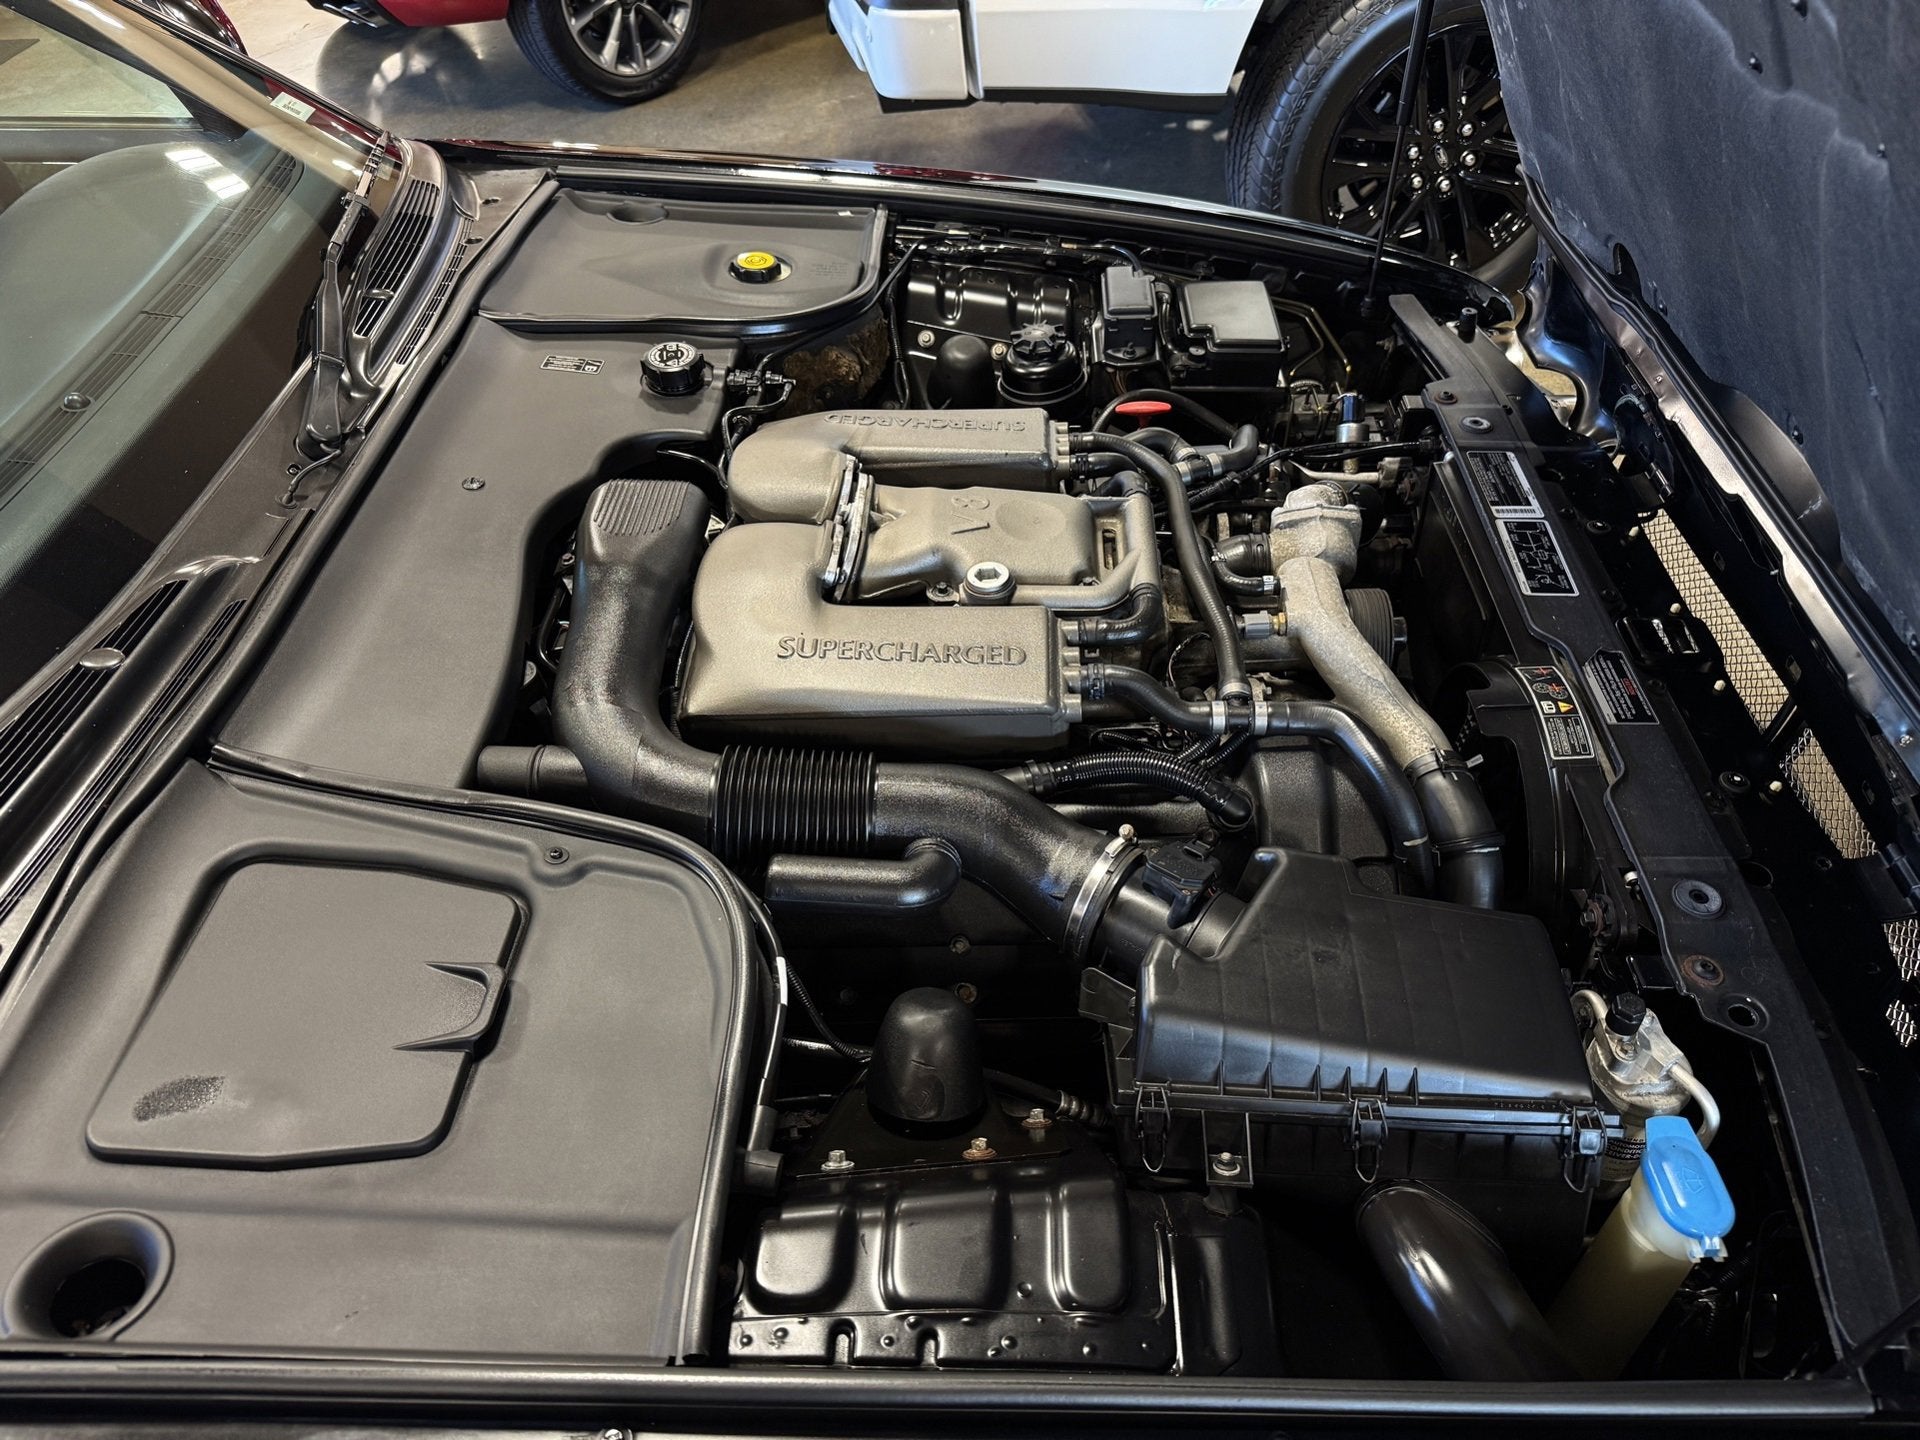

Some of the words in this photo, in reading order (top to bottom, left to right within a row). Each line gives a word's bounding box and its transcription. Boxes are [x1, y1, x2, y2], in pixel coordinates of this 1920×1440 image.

[824, 413, 1027, 432] SUPERCHARGED
[951, 496, 991, 536] V8
[777, 637, 1027, 666] SUPERCHARGED
